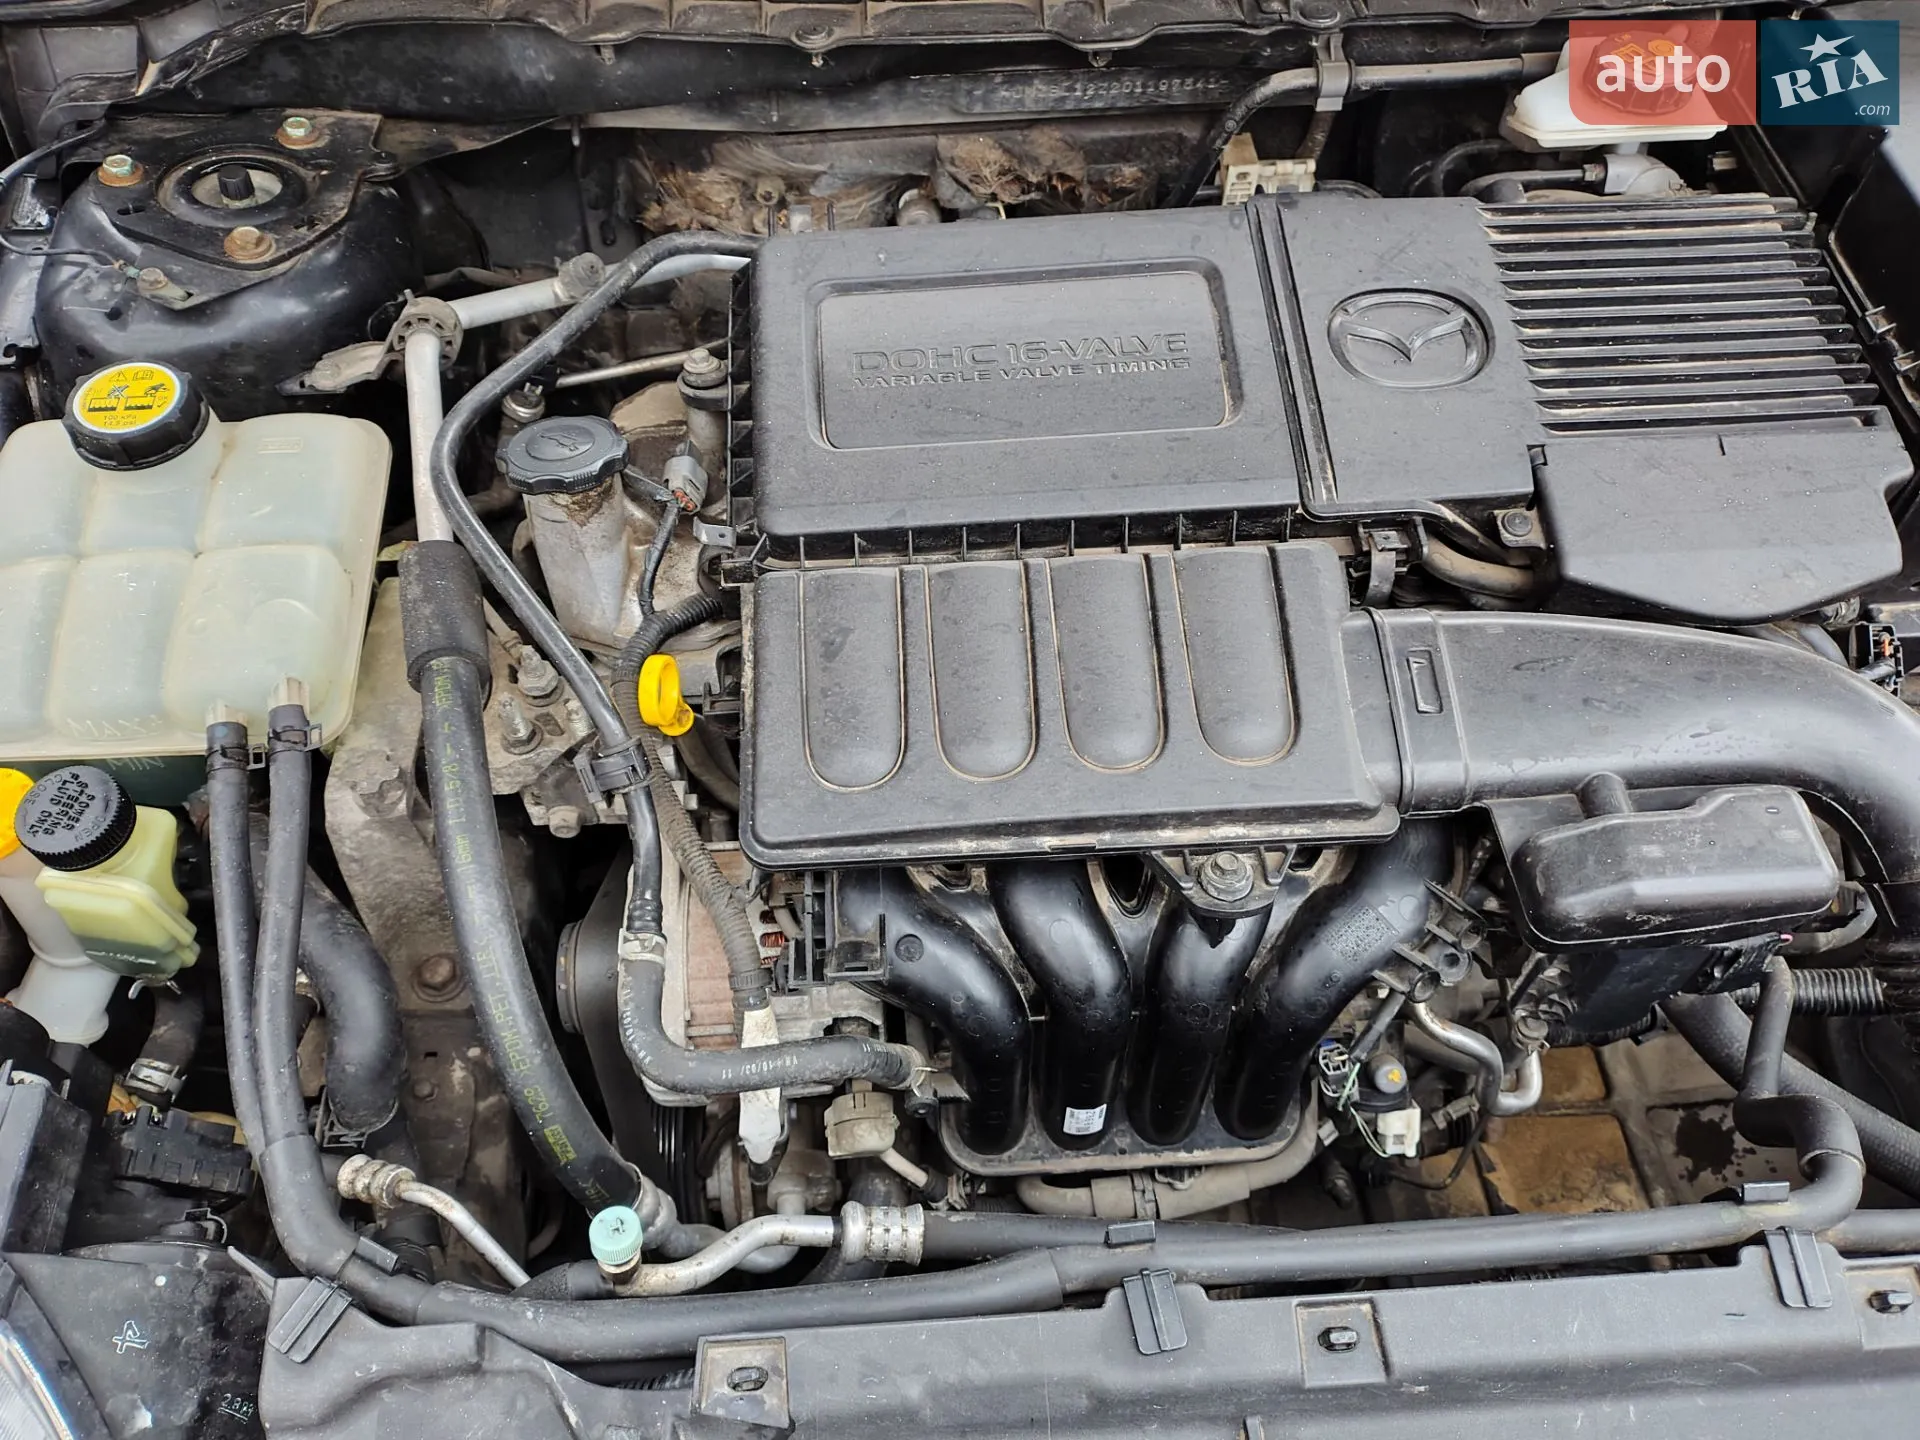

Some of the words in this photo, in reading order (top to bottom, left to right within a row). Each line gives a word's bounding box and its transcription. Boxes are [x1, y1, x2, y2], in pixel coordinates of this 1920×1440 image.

[853, 344, 999, 373] DOHC
[1006, 333, 1189, 366] 16-VALVE
[853, 369, 992, 389] VARIABLE
[1000, 364, 1085, 380] VALVE
[1092, 357, 1191, 375] TIMING
[105, 757, 165, 771] MIN
[23, 773, 63, 806] CLOSE
[26, 809, 54, 838] ONLY
[61, 792, 96, 832] POWER
